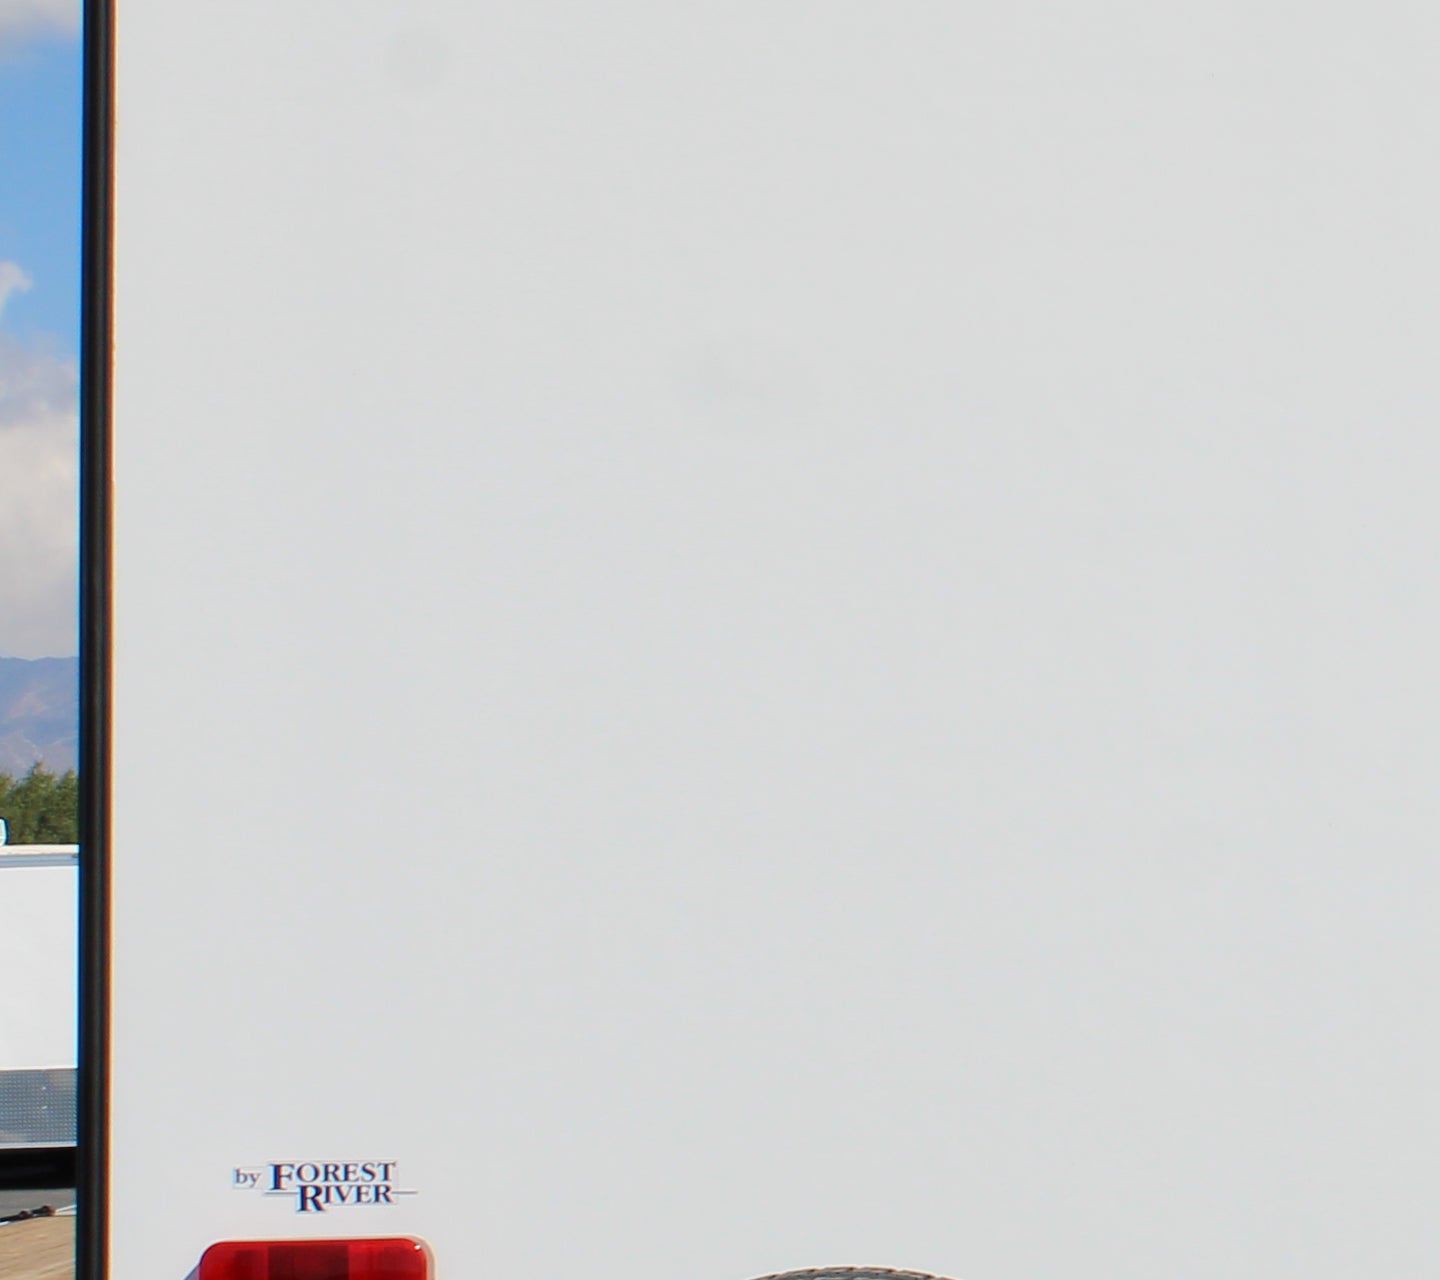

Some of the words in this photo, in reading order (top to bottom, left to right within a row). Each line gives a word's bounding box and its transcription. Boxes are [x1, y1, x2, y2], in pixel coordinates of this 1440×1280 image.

[233, 1168, 261, 1189] by
[268, 1161, 398, 1191] FOREST
[296, 1184, 395, 1213] RIVER
